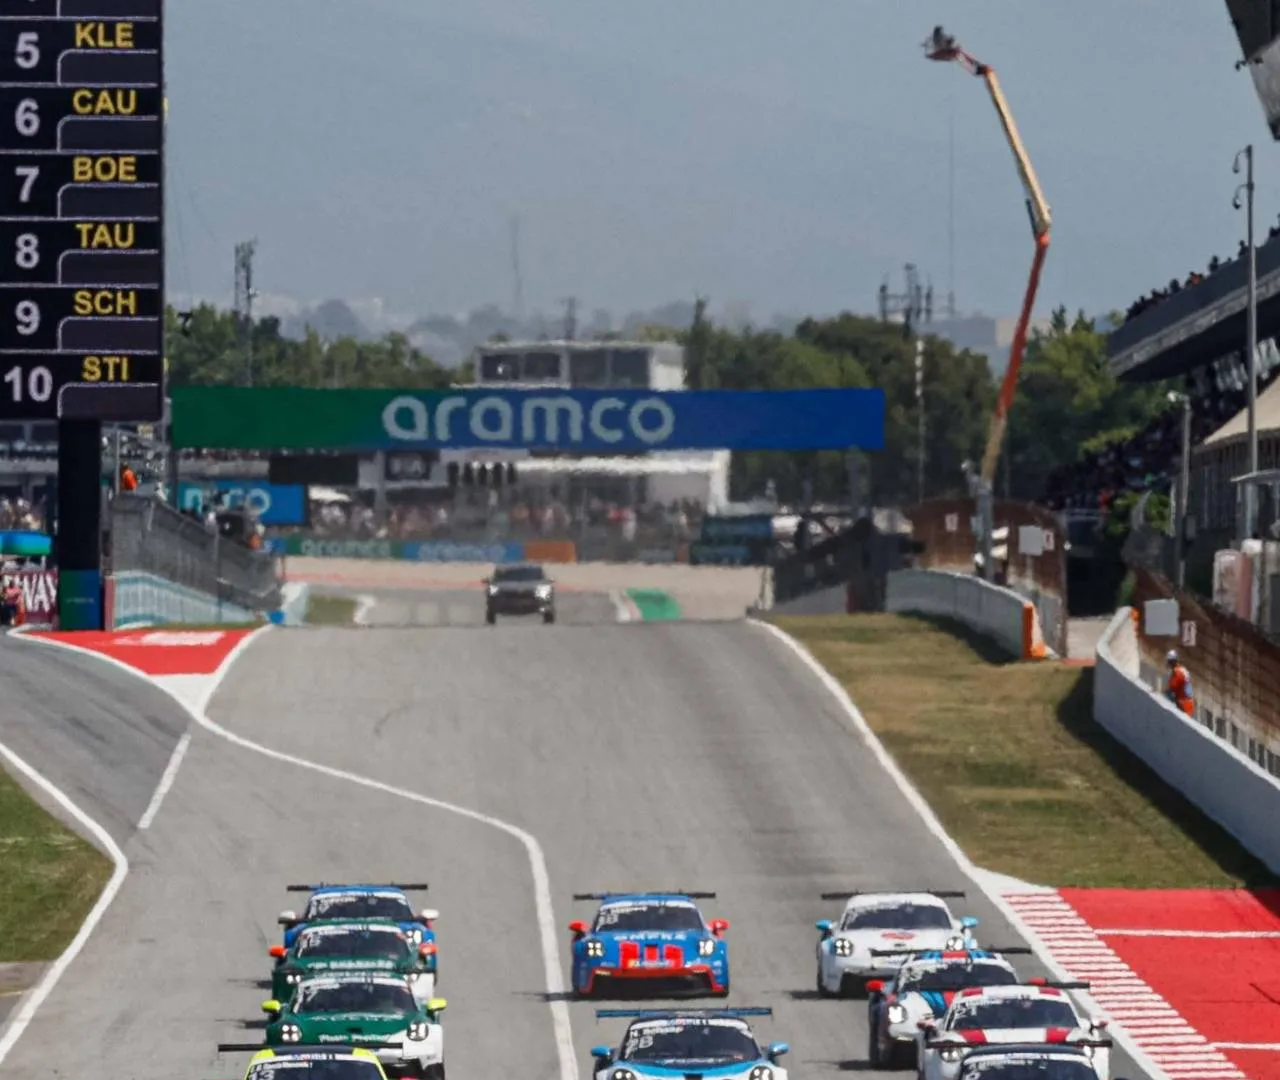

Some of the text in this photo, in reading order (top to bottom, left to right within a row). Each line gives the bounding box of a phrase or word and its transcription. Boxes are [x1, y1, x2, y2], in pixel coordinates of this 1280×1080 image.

[14, 22, 134, 69] 5 KLE
[14, 89, 137, 136] 6 CAU
[14, 156, 137, 203] 7 BOE
[14, 223, 135, 269] 8 TAU
[14, 290, 137, 335] 9 SCH
[4, 356, 129, 402] 10 STI
[381, 395, 675, 443] aramco
